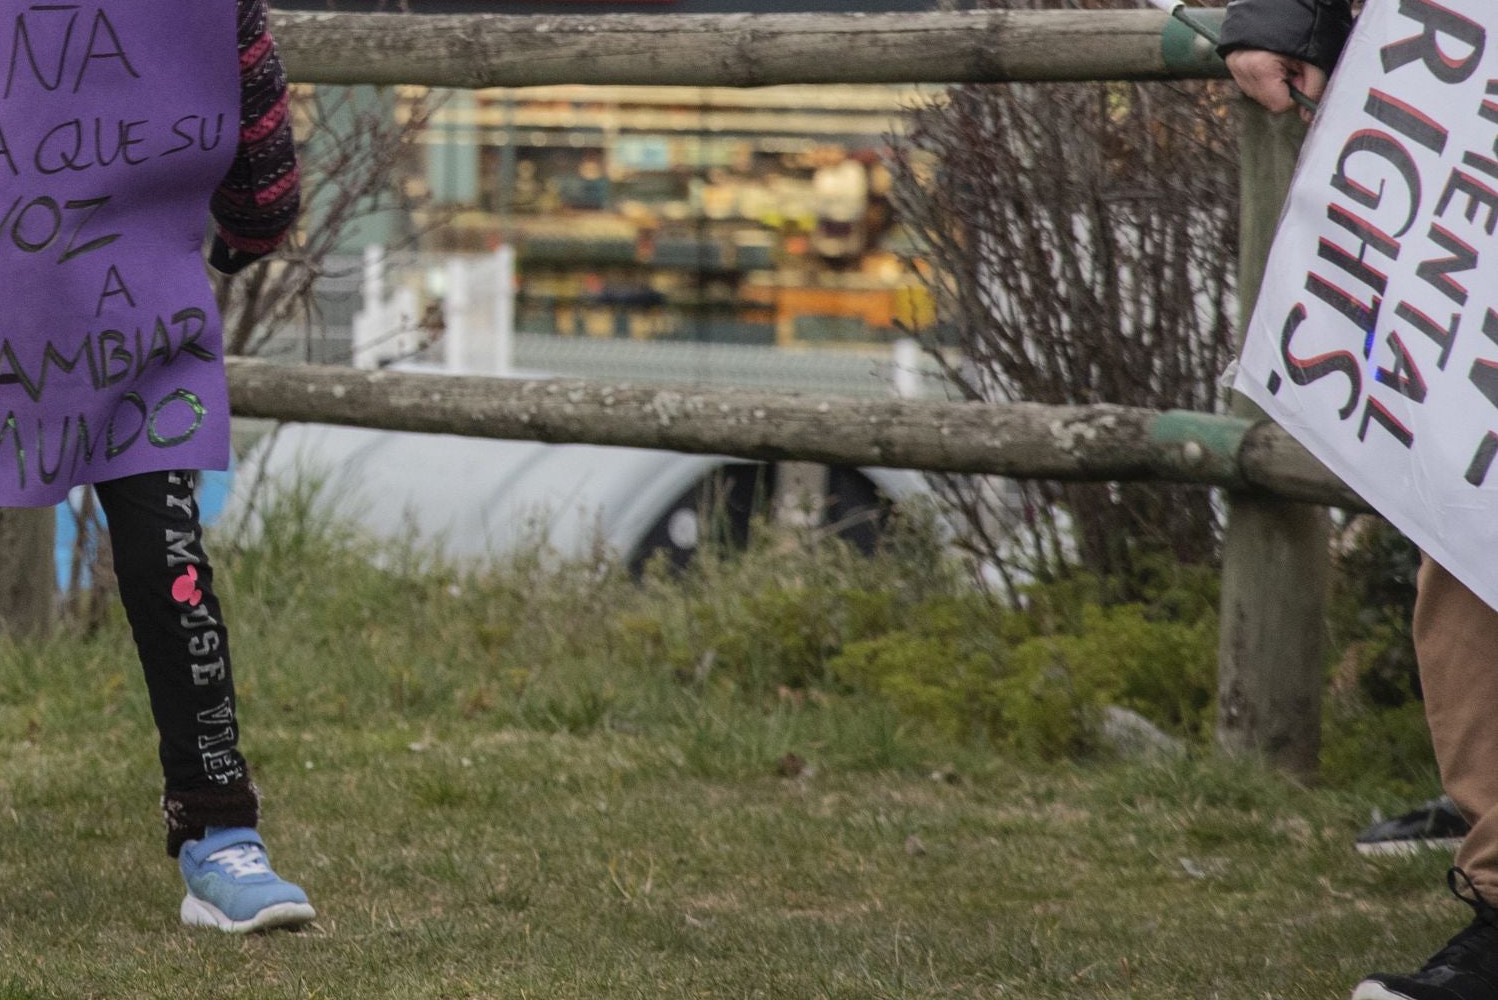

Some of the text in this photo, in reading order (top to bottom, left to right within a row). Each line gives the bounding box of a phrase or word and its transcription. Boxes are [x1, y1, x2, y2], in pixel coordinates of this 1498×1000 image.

[34, 117, 150, 176] QUE
[158, 112, 225, 158] SU
[95, 263, 137, 318] A
